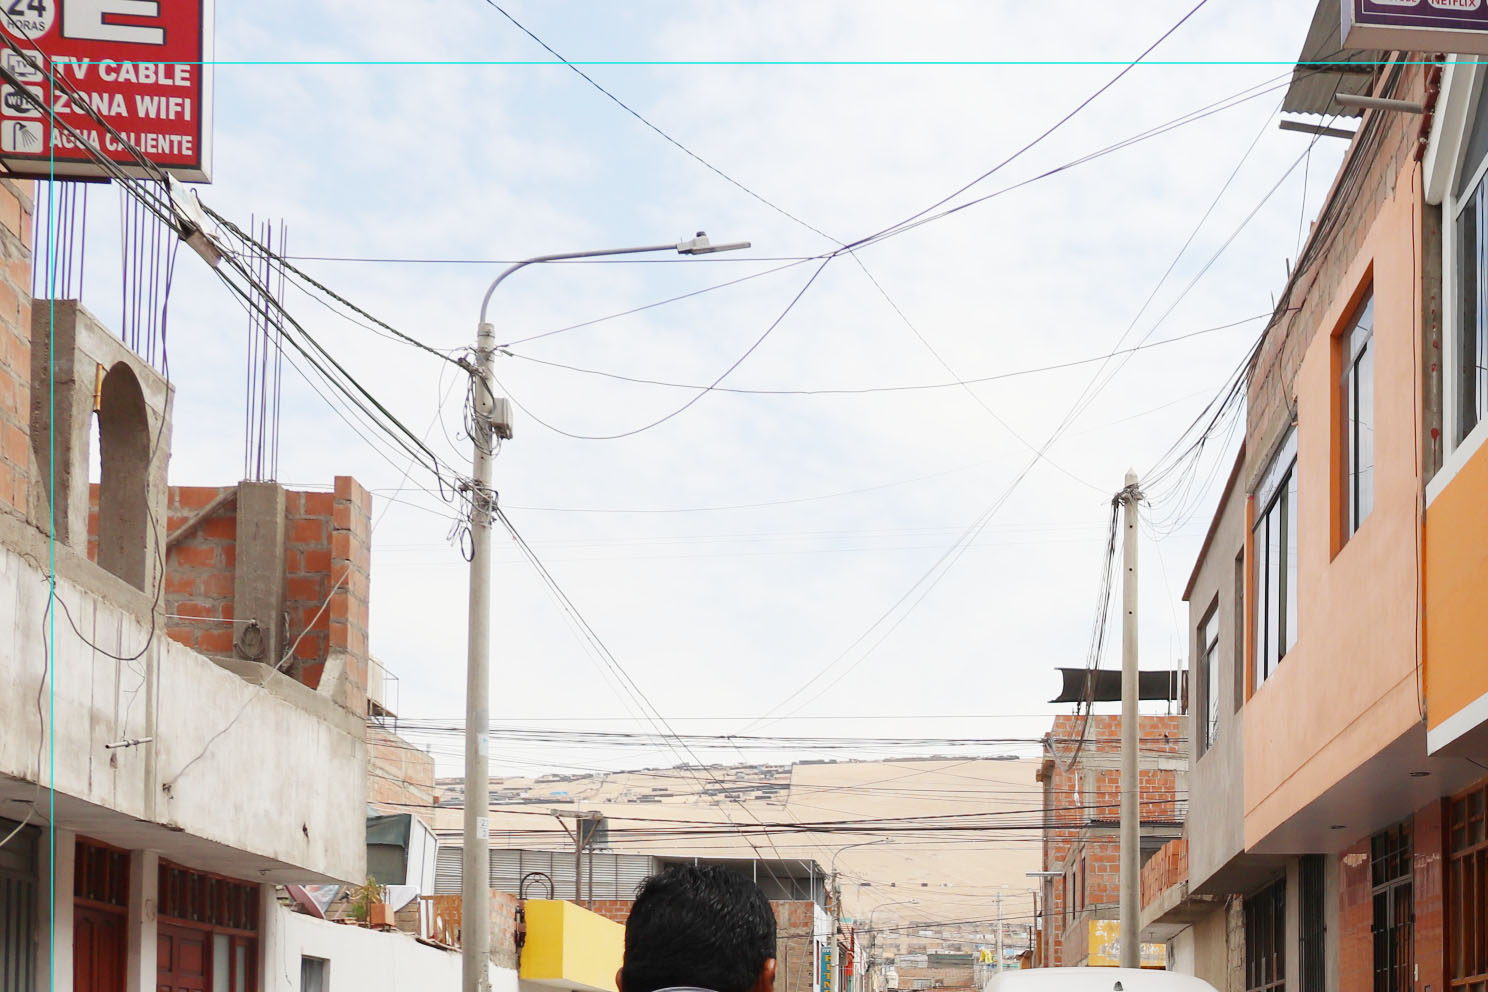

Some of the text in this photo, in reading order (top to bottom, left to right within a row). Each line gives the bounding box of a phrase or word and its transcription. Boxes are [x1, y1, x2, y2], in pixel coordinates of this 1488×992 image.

[7, 19, 46, 32] HORAS
[51, 55, 191, 87] TV CABLE
[53, 89, 191, 121] ZONA WIFI
[49, 127, 193, 156] AGUA CALIENTE
